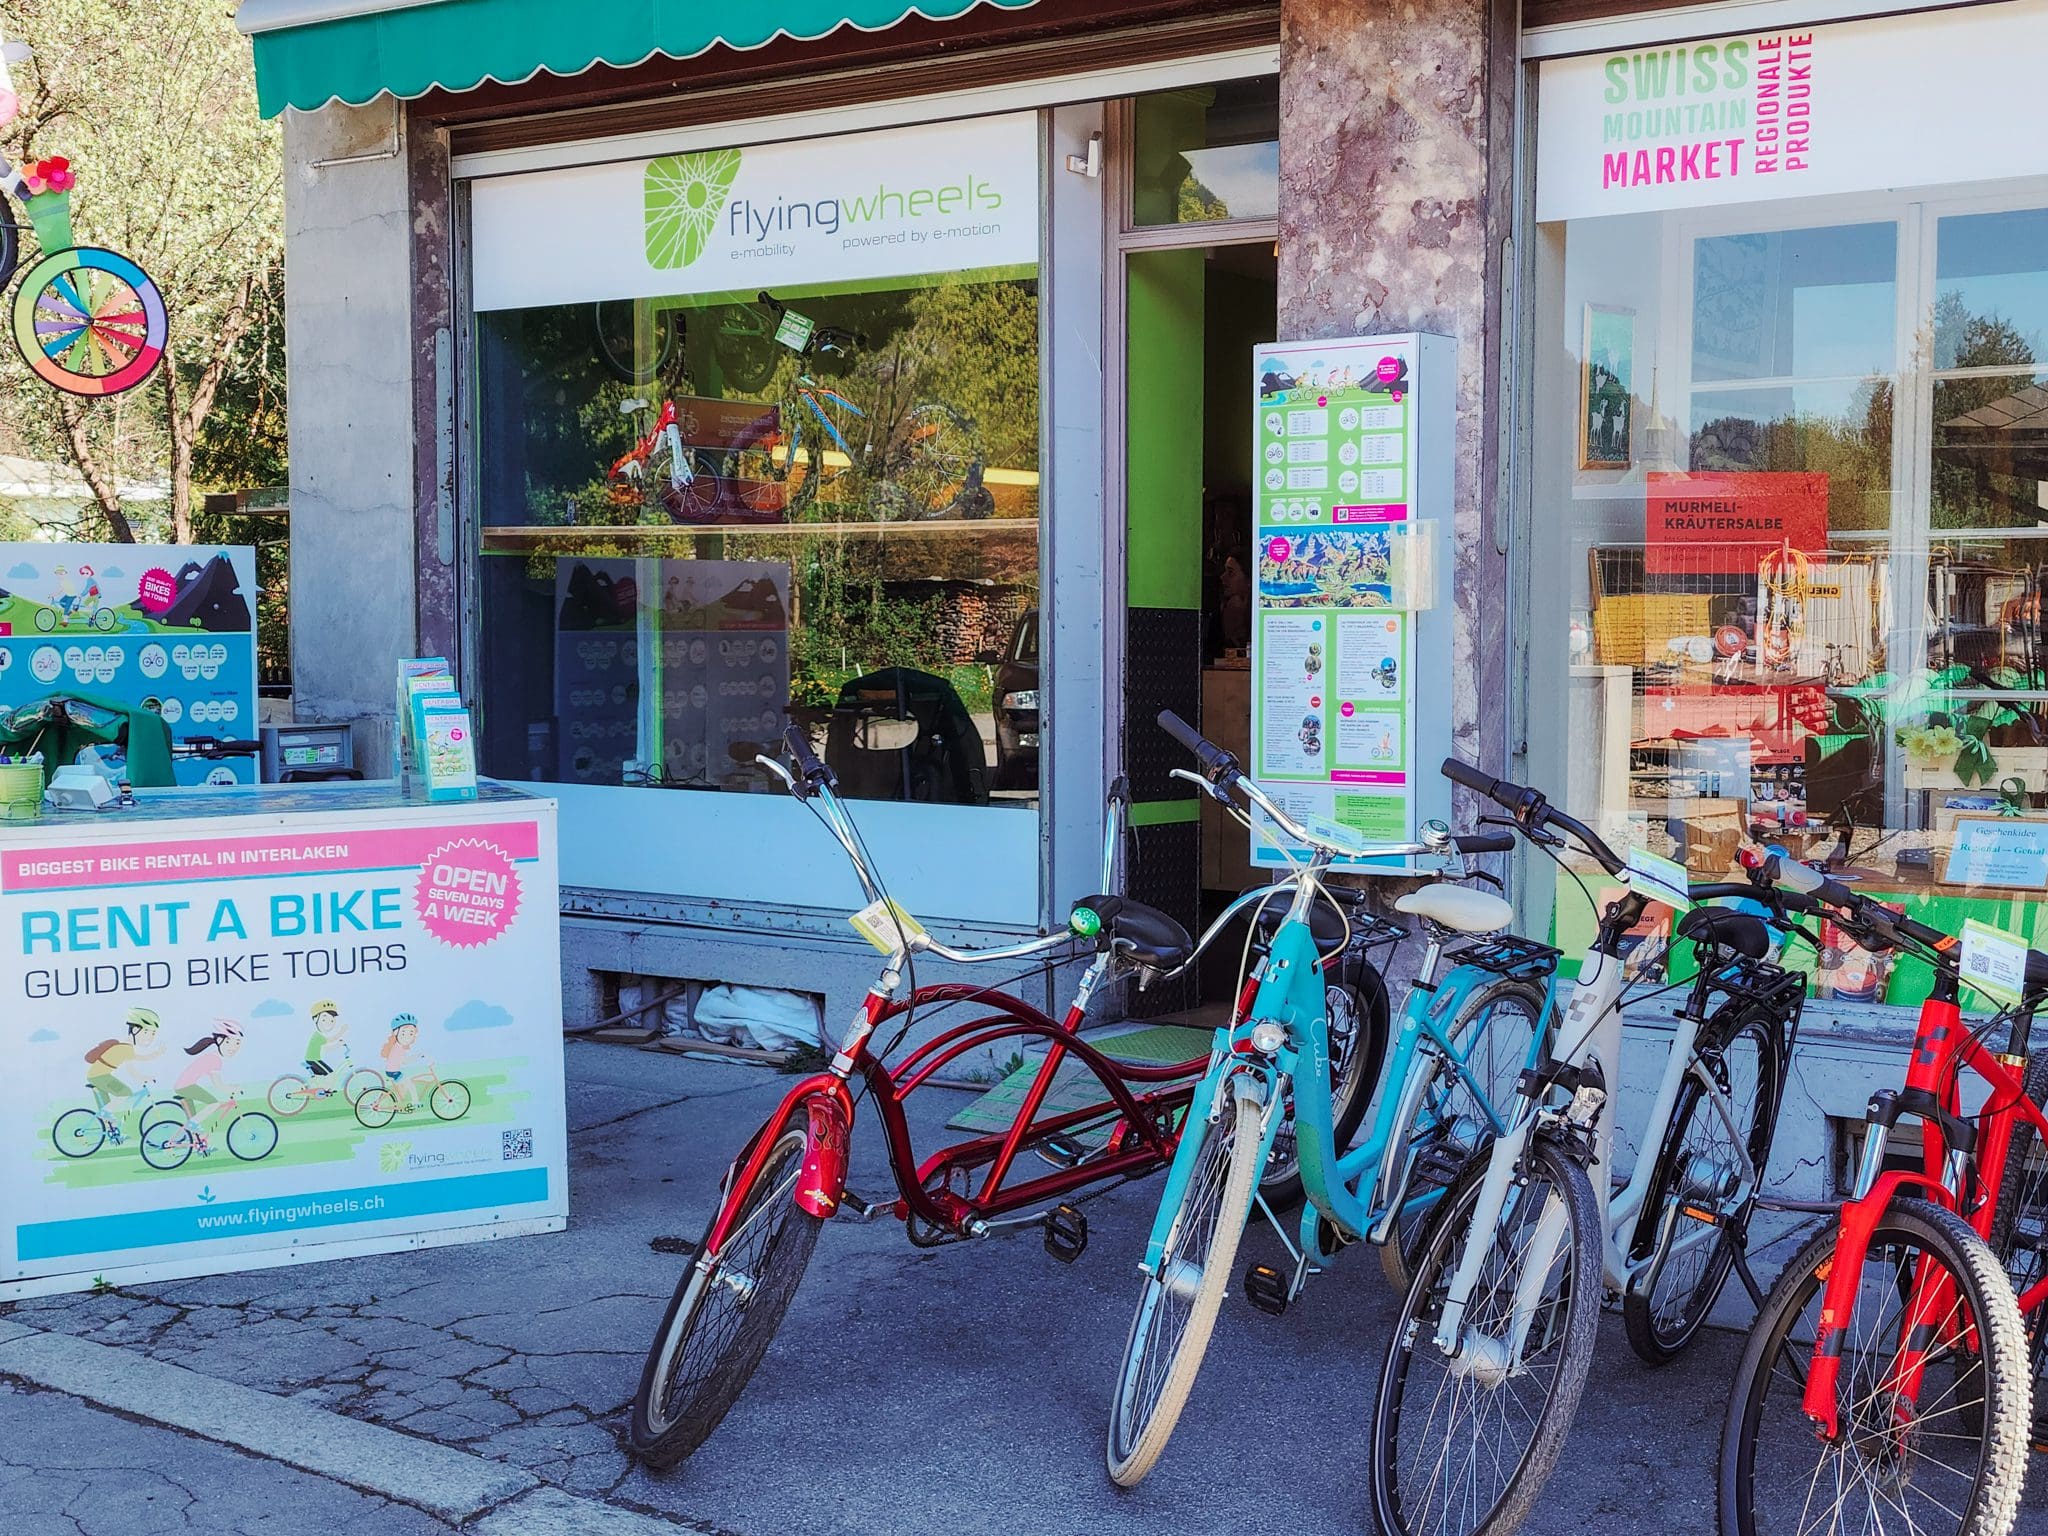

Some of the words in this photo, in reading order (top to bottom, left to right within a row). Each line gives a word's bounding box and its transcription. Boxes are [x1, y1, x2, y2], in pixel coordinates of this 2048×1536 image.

[1604, 40, 1749, 105] SWISS
[1755, 36, 1782, 174] REGIONALE
[1785, 32, 1813, 171] PRODUKTE
[1603, 98, 1746, 145] MOUNTAIN
[1603, 138, 1745, 190] MARKET
[729, 174, 1002, 242] flyingwheels
[730, 242, 796, 260] e-mobility
[842, 230, 905, 250] powered
[911, 228, 928, 244] by
[933, 223, 1001, 241] e-motion
[1665, 502, 1743, 514] MURMELI-
[1665, 515, 1783, 530] KRÄUTERSALBE
[145, 582, 171, 596] BIKES
[151, 593, 169, 604] TOWN
[18, 860, 94, 878] BIGGEST
[99, 855, 140, 872] BIKE
[144, 851, 212, 869] RENTAL
[217, 849, 236, 865] IN
[240, 844, 349, 864] INTERLAKEN
[432, 864, 508, 896] OPEN
[428, 888, 469, 904] SEVEN
[471, 895, 505, 909] DAYS
[21, 901, 190, 955] RENT
[206, 898, 248, 942] A
[270, 887, 403, 938] BIKE
[423, 903, 439, 919] A
[443, 905, 499, 928] WEEK
[24, 961, 172, 999] GUIDED
[187, 954, 270, 987] BIKE
[282, 944, 408, 979] TOURS
[1310, 1017, 1329, 1084] Cube
[197, 1196, 386, 1229] www.flyingwheels.ch
